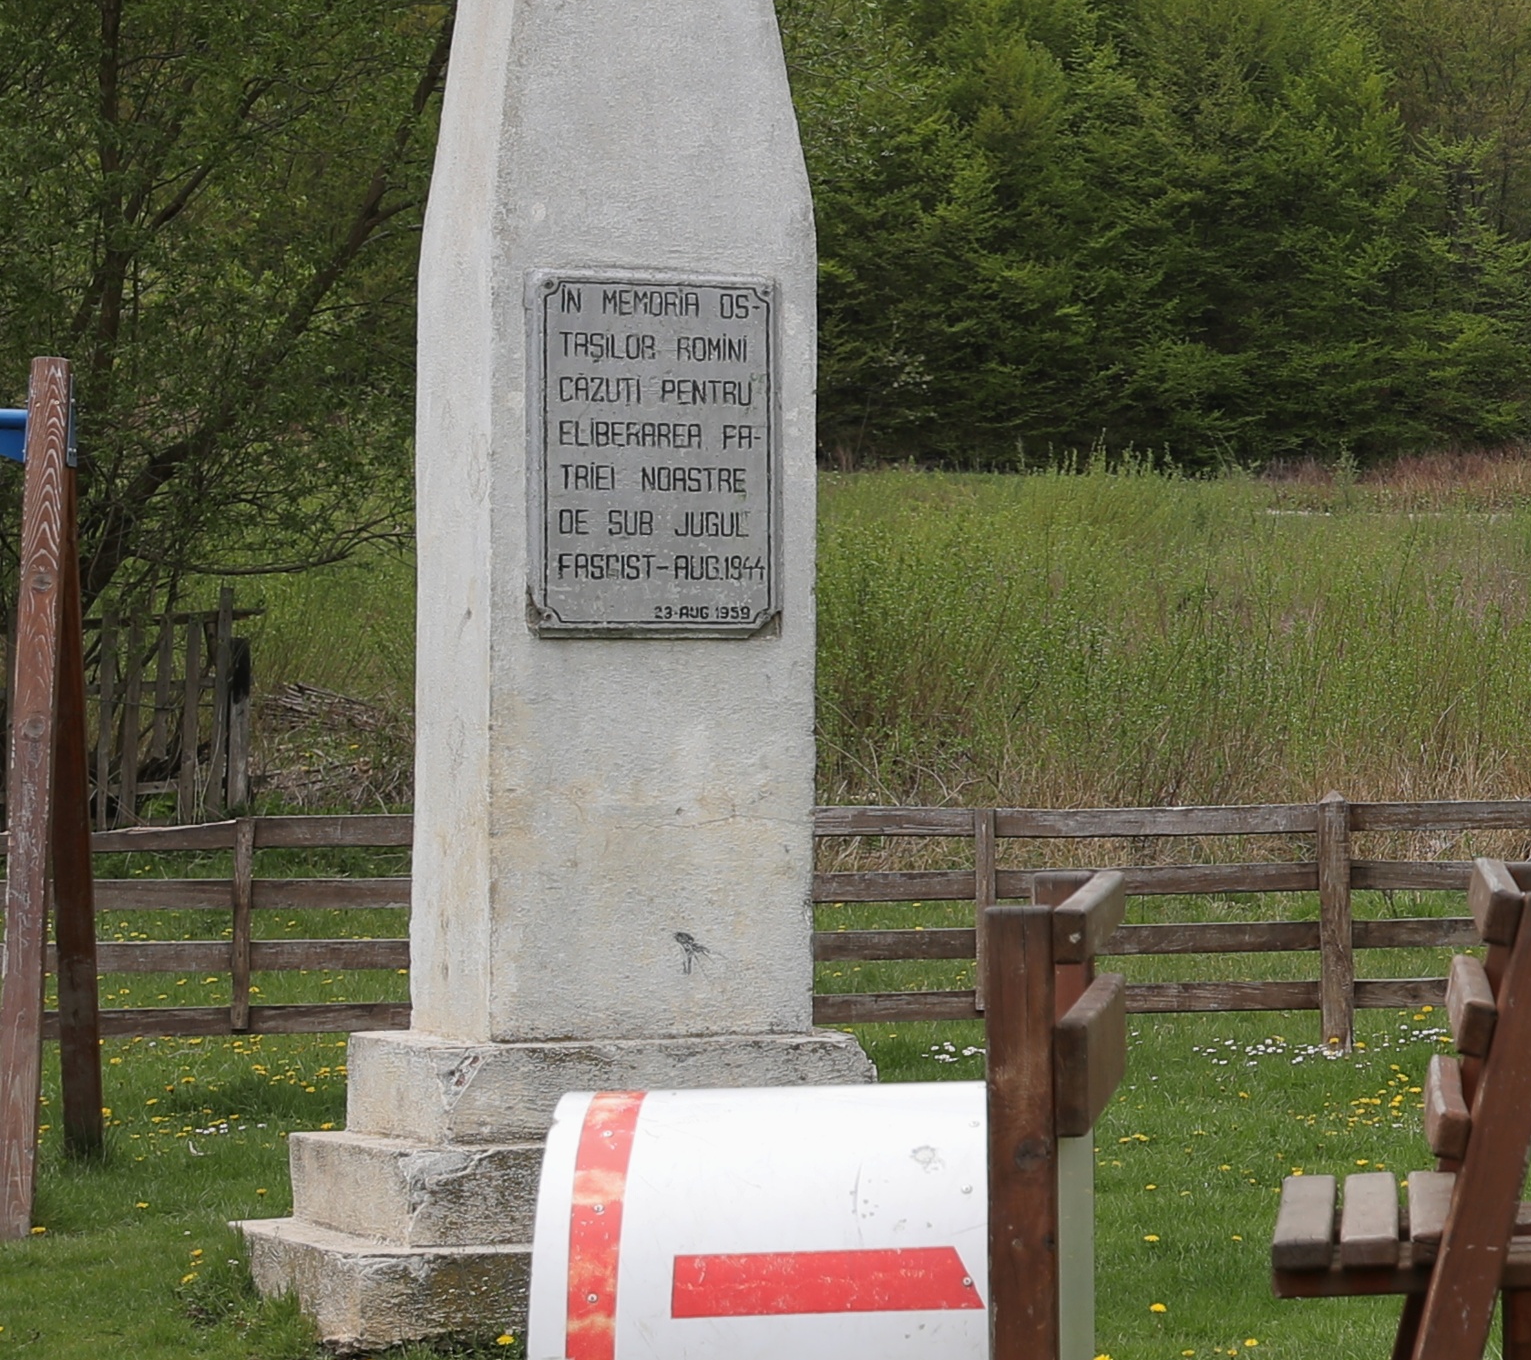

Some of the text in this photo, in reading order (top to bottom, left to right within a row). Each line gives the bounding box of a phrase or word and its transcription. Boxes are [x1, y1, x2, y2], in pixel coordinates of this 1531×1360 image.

[602, 289, 700, 317] MEMORIA
[719, 293, 760, 320] OS-
[661, 379, 753, 407] PENTRU
[559, 417, 702, 449] ELIBERAREA
[560, 461, 748, 494] TRIEI NOASTRE
[559, 508, 750, 538] DE SUB JUGUL
[715, 605, 751, 620] 1959
